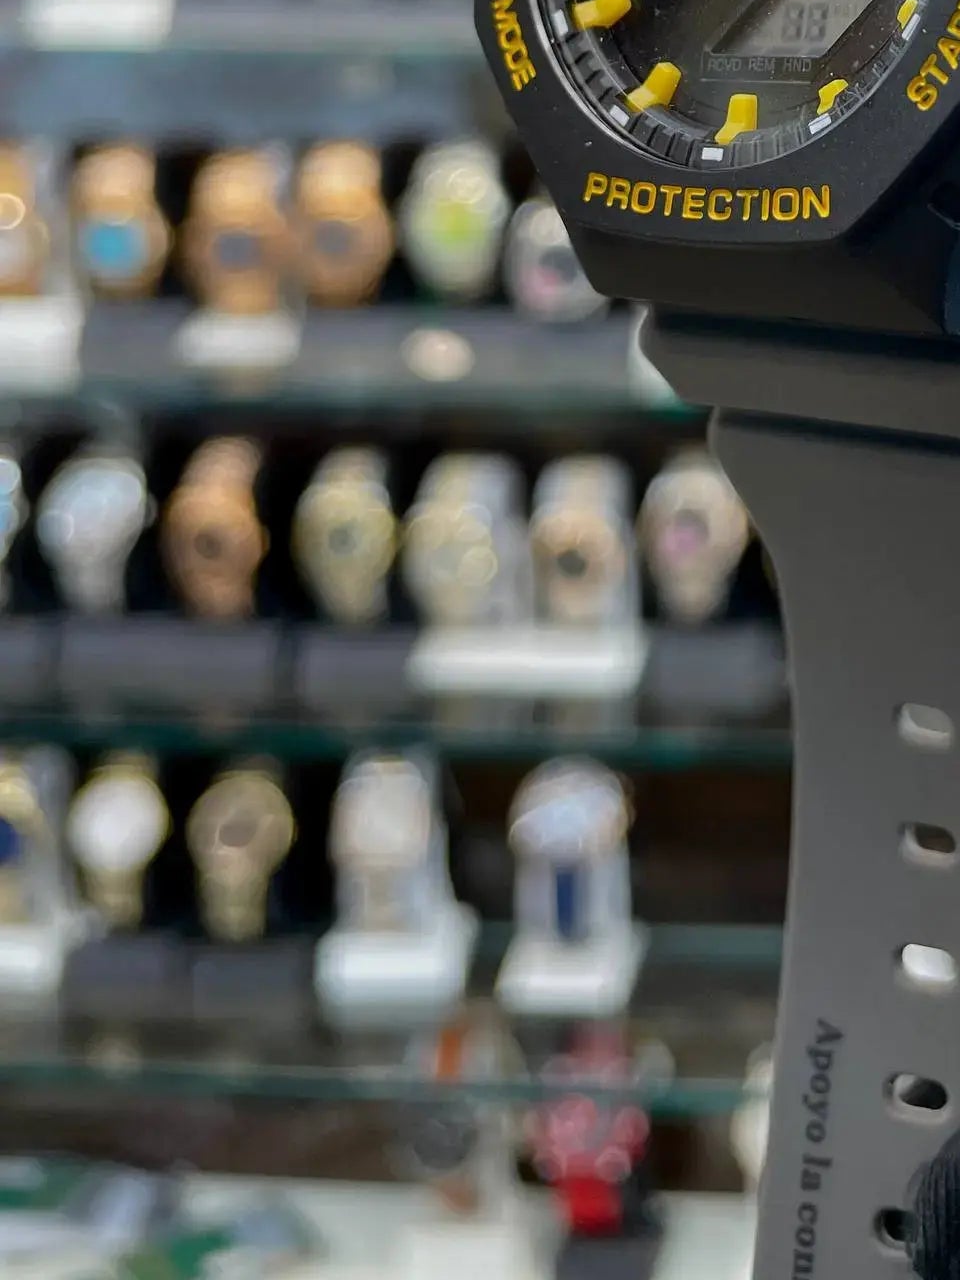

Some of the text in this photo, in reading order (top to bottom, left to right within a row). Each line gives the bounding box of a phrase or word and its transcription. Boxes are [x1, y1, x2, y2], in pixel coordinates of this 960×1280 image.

[748, 57, 777, 71] REM
[784, 57, 813, 72] HND
[582, 171, 831, 222] PROTECTION
[791, 1018, 844, 1280] Apoyo la con
